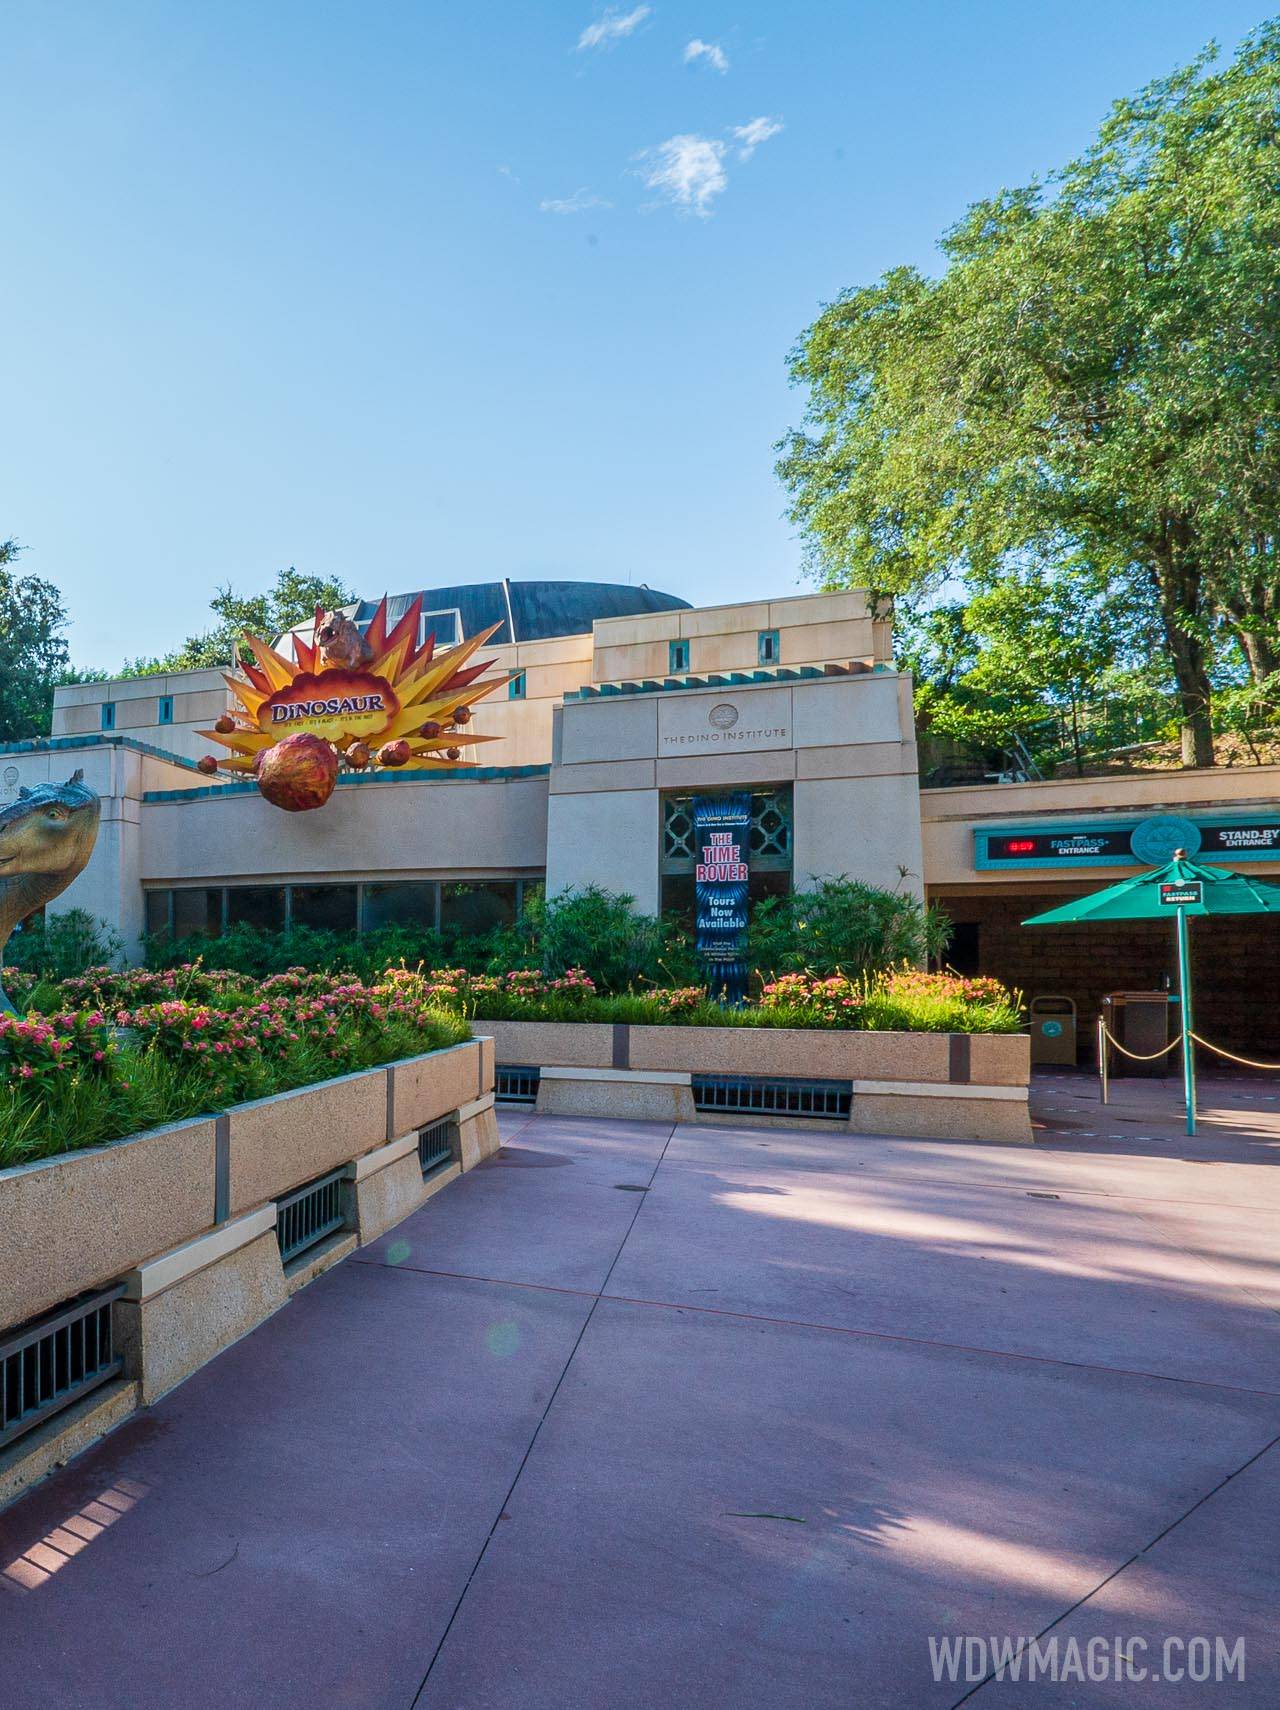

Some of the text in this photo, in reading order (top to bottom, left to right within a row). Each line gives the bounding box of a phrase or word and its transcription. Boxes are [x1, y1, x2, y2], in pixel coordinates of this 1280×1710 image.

[271, 694, 385, 723] DINOSAUR
[664, 728, 787, 744] THE DINO INSTITUTE
[710, 832, 732, 845] THE
[1219, 829, 1280, 840] STAND-BY
[1226, 839, 1272, 847] ENTRANCE
[702, 845, 740, 863] TIME
[1058, 847, 1100, 855] ENTRANCE
[696, 863, 748, 882] ROVER
[708, 896, 735, 906] Tours
[710, 907, 733, 917] Now
[698, 917, 745, 928] Available
